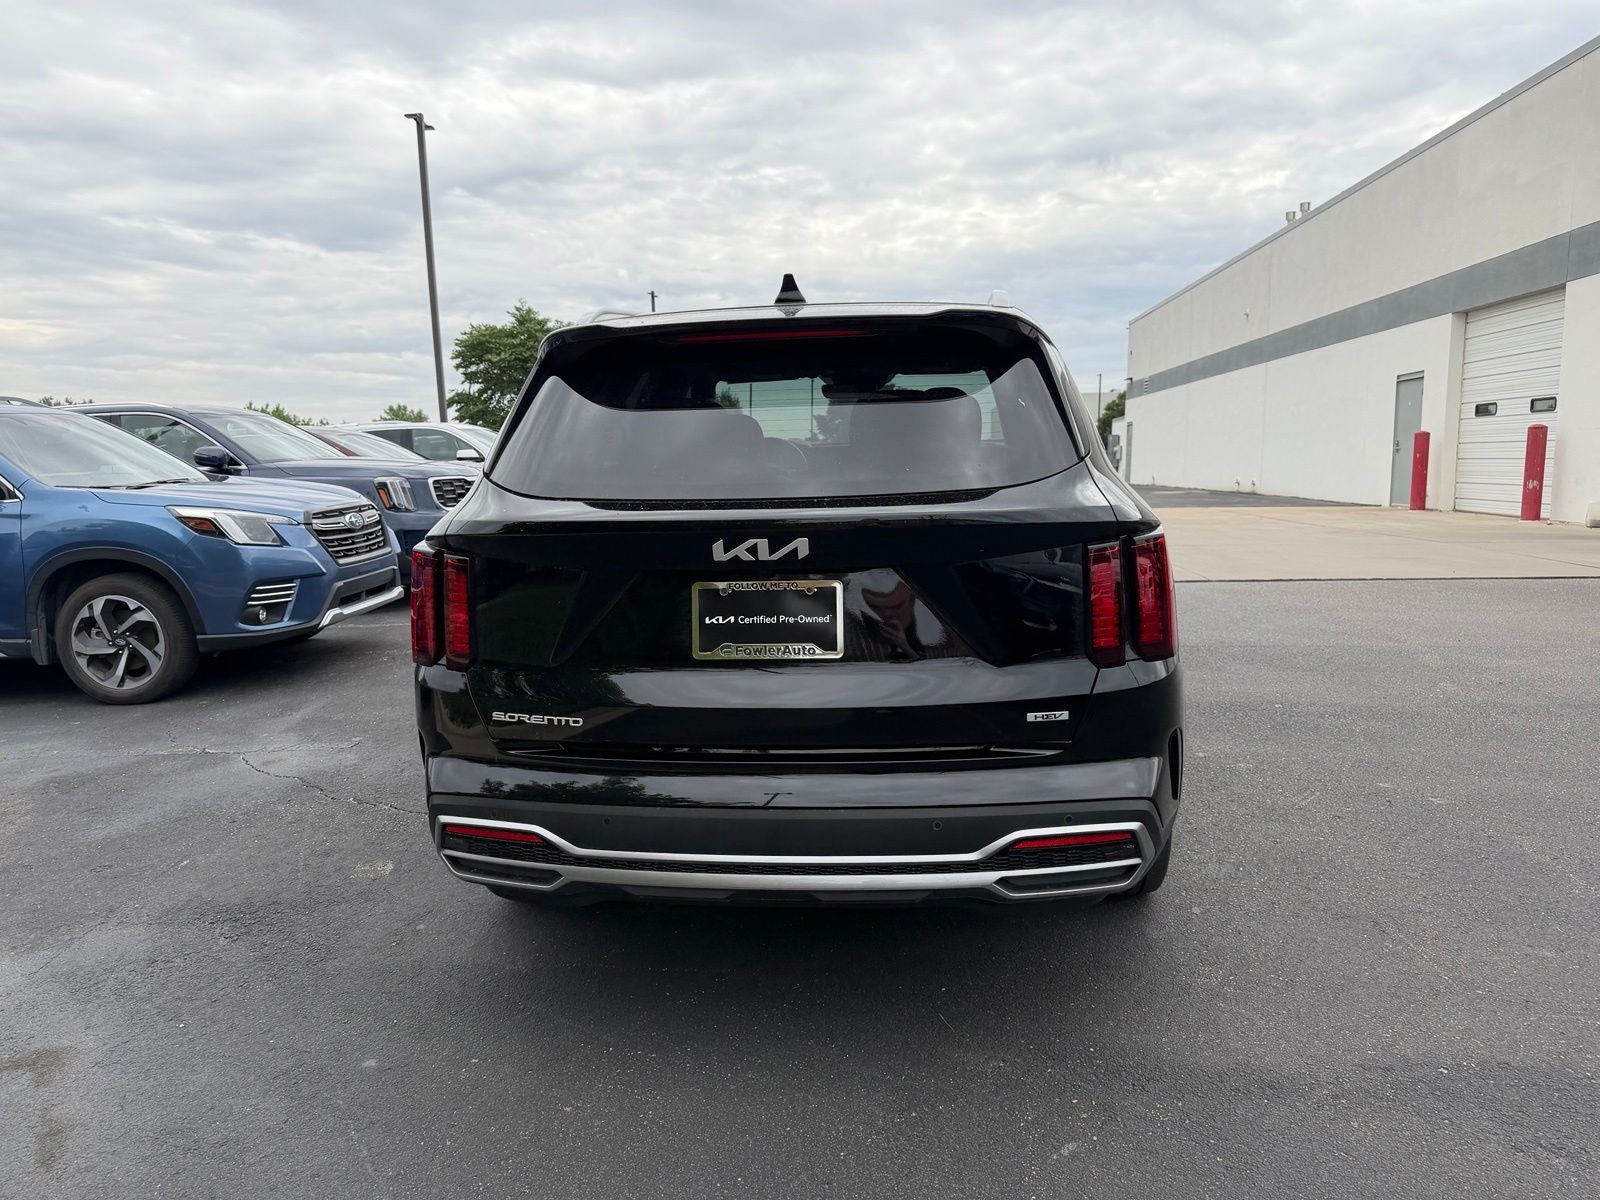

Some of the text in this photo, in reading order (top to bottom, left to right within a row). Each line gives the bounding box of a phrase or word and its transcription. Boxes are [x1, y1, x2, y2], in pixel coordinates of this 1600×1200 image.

[712, 537, 810, 562] KIA
[728, 582, 768, 591] FOLLOW
[769, 582, 785, 590] ME
[705, 615, 735, 625] KIA
[738, 615, 777, 624] Certified
[735, 644, 817, 657] FowlerAuto
[492, 711, 584, 727] SORENTO
